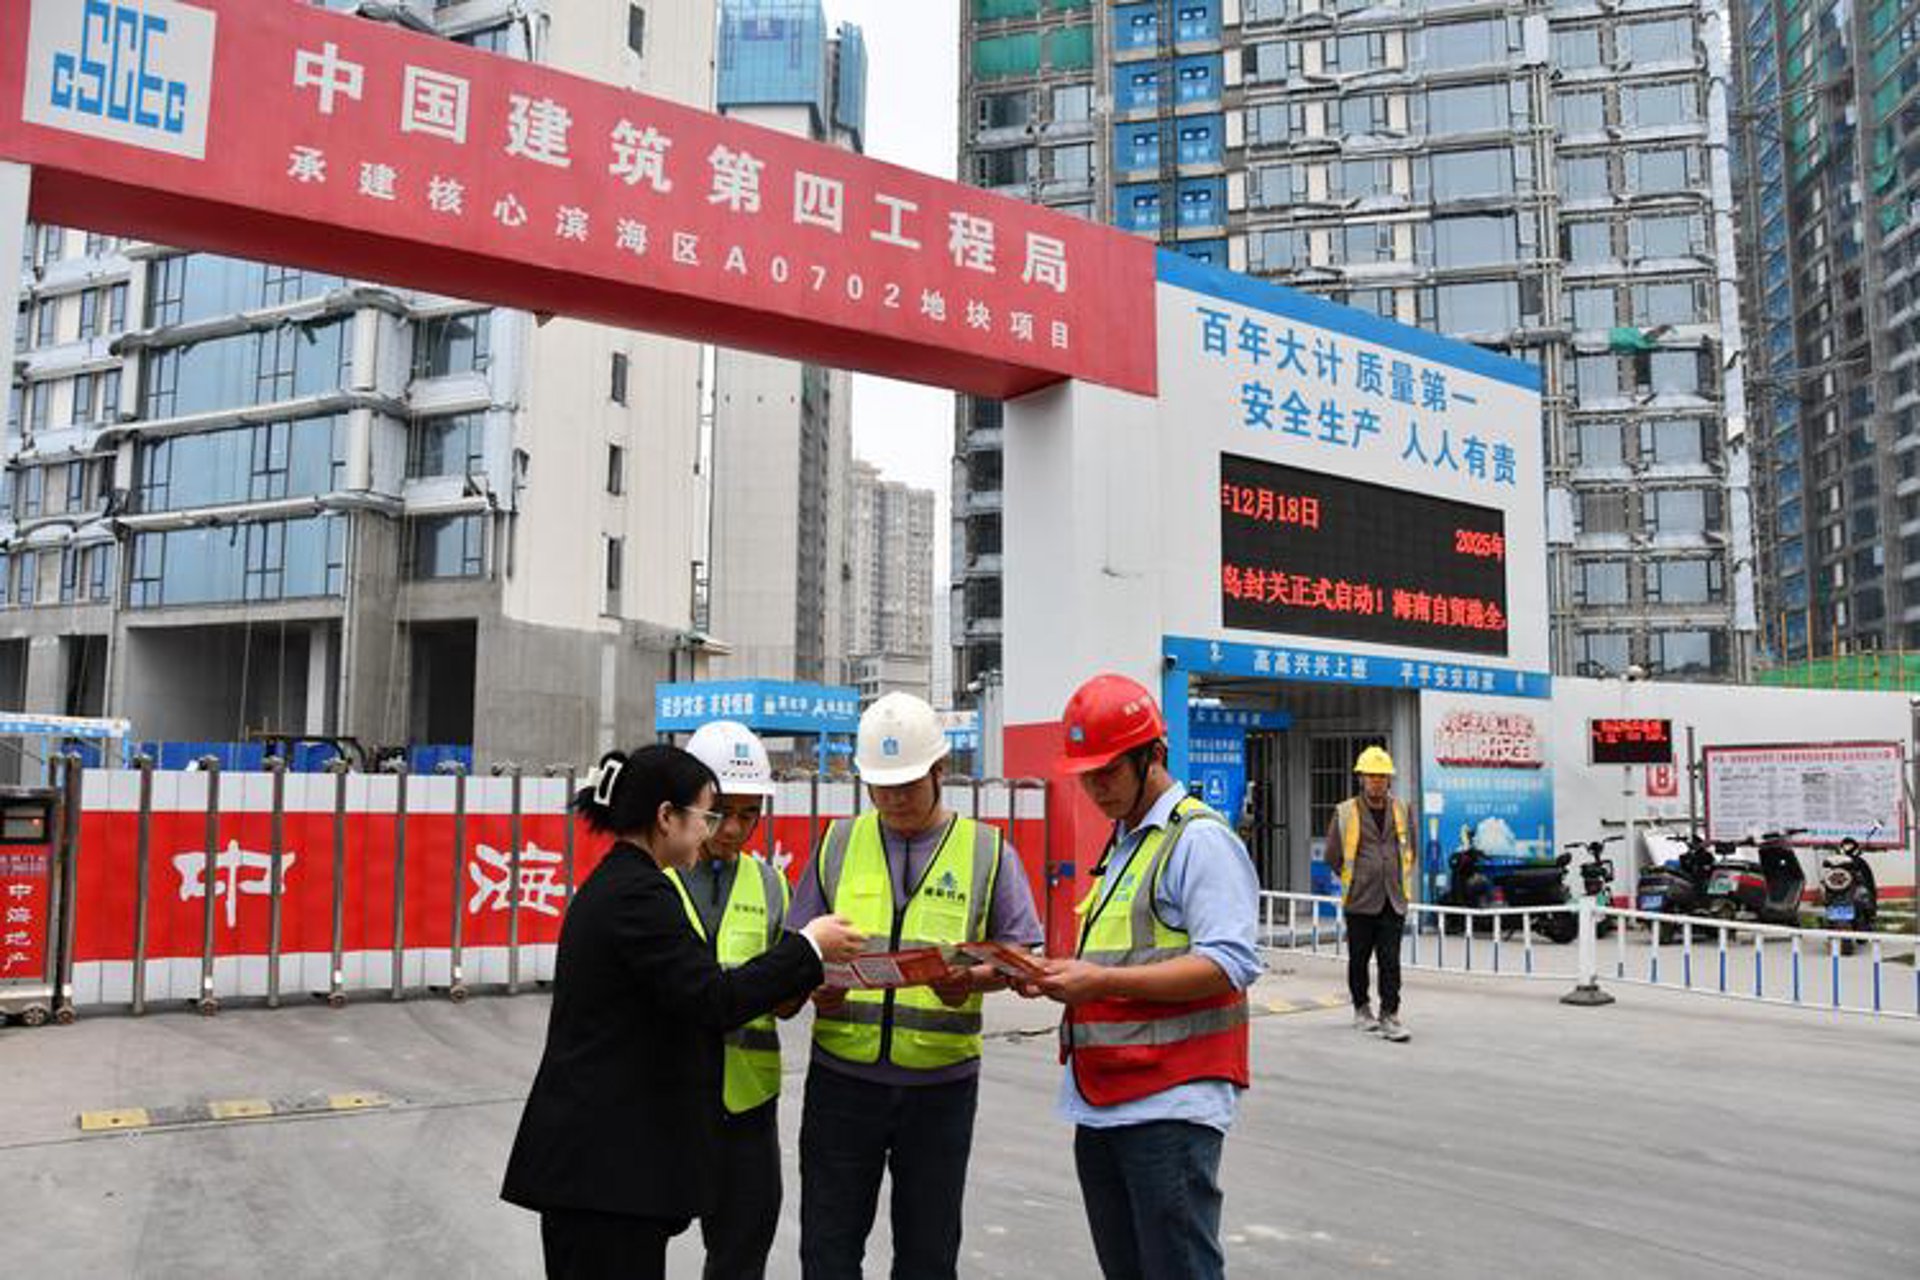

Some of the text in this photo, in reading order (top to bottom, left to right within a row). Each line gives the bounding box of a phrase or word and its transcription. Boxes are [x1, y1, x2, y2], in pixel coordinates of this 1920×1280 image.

[292, 42, 1068, 293] 中国建筑第四工程局
[287, 144, 1069, 350] 承建核心滨海区A0702地块项目
[1197, 306, 1477, 413] 百年大计 质量第一
[1241, 380, 1517, 486] 安全生产 人人有责
